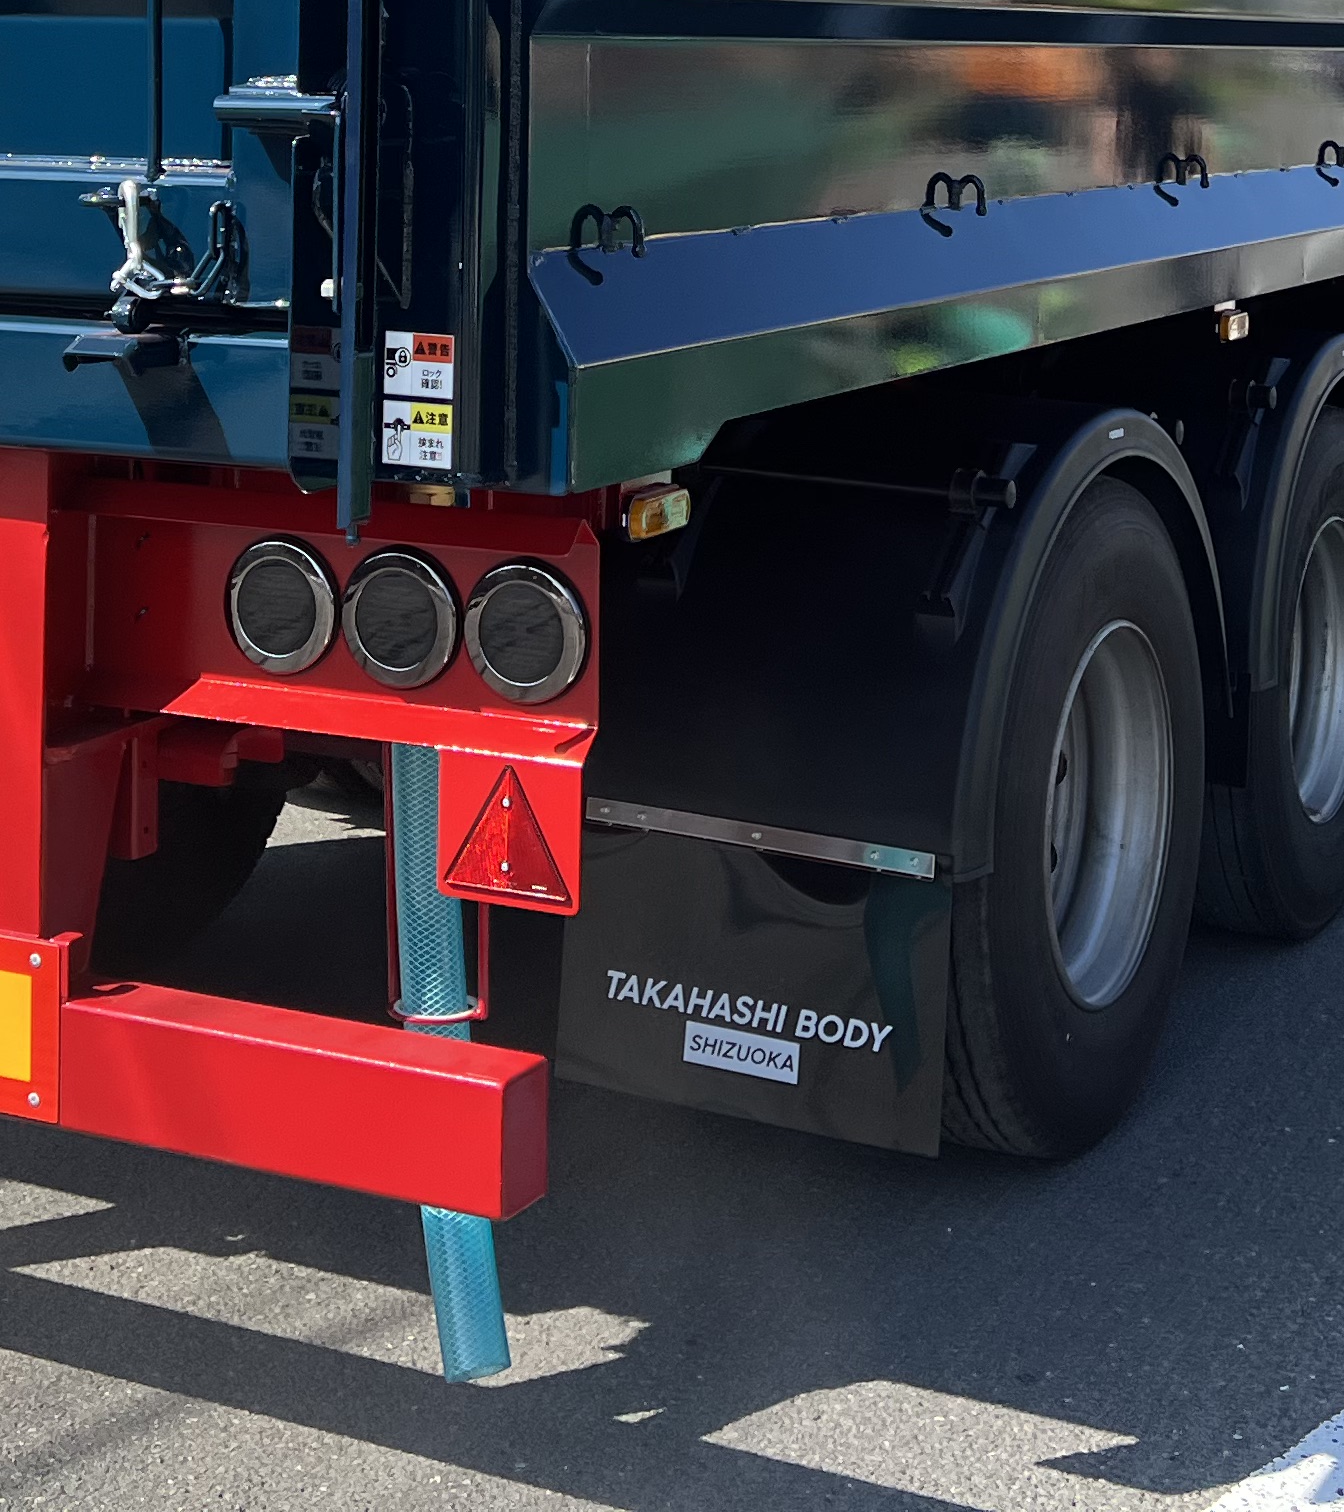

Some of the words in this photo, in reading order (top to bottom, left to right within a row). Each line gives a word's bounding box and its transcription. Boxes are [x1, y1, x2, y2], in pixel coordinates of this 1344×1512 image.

[428, 342, 450, 356] 警告
[422, 369, 442, 379] ロック
[425, 412, 449, 426] 注意
[607, 970, 788, 1033] TAKAHASHI
[794, 1009, 894, 1053] BODY
[689, 1034, 794, 1073] SHIZUOKA
